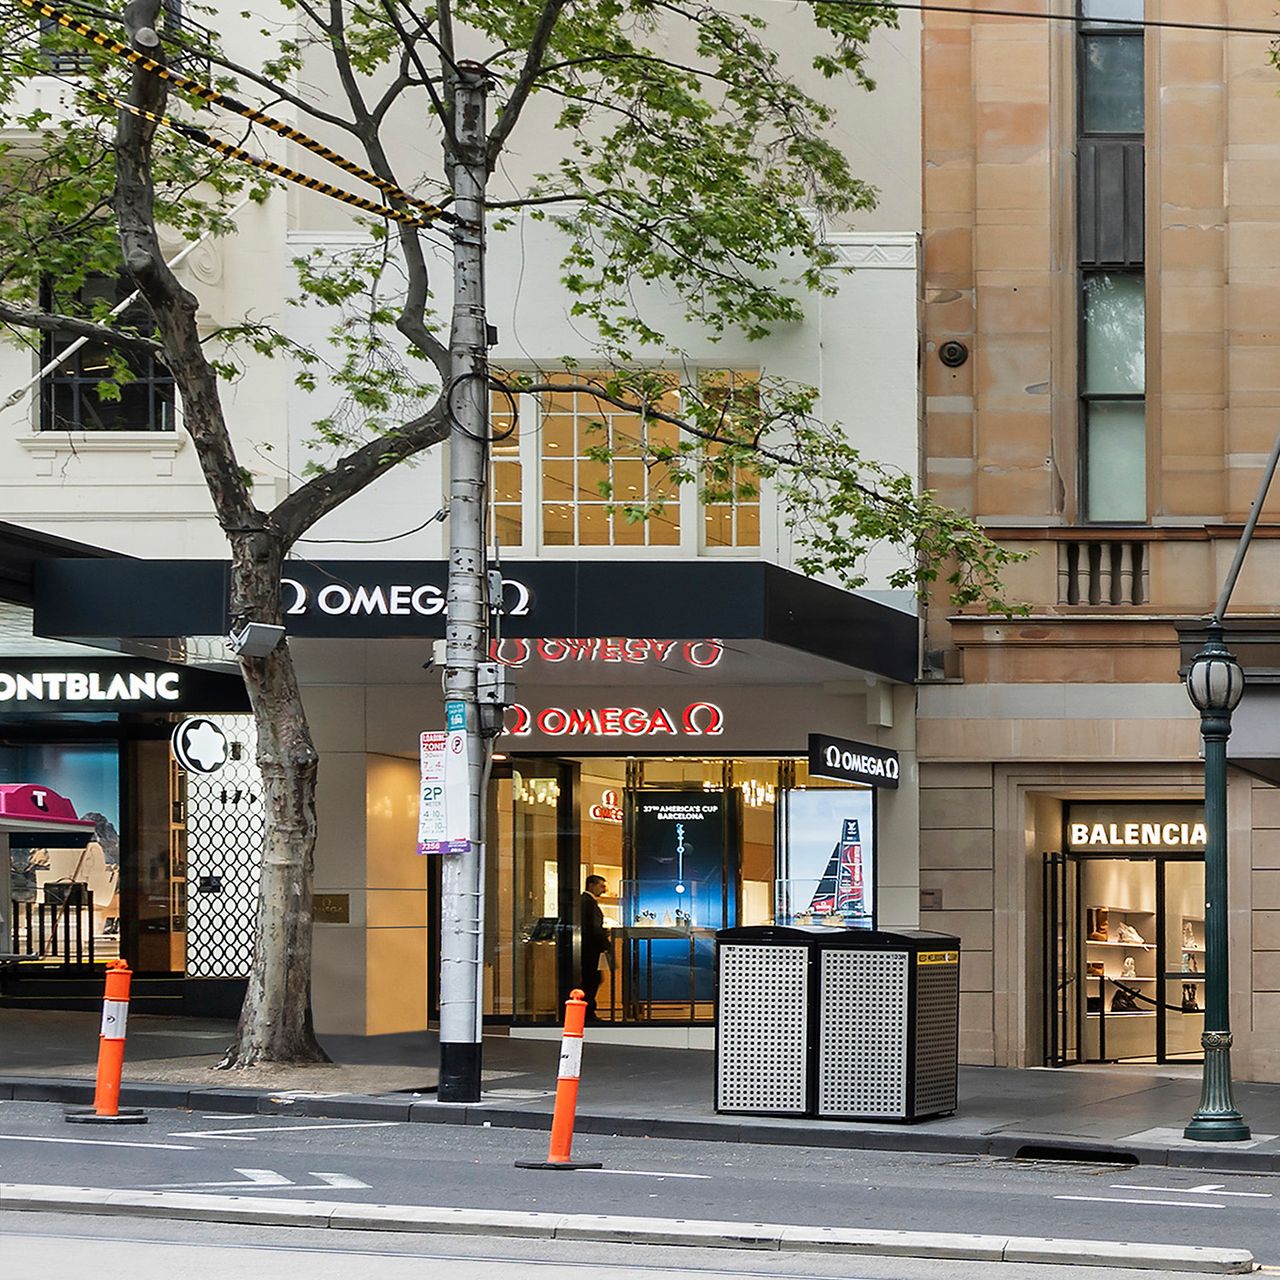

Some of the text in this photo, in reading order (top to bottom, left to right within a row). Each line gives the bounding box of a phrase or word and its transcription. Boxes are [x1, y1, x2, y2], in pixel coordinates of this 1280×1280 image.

[317, 584, 450, 616] OMEG
[537, 707, 678, 736] OMEGA
[842, 751, 885, 777] OMEGA
[423, 786, 443, 801] 2P
[1071, 823, 1207, 845] BALENCIA
